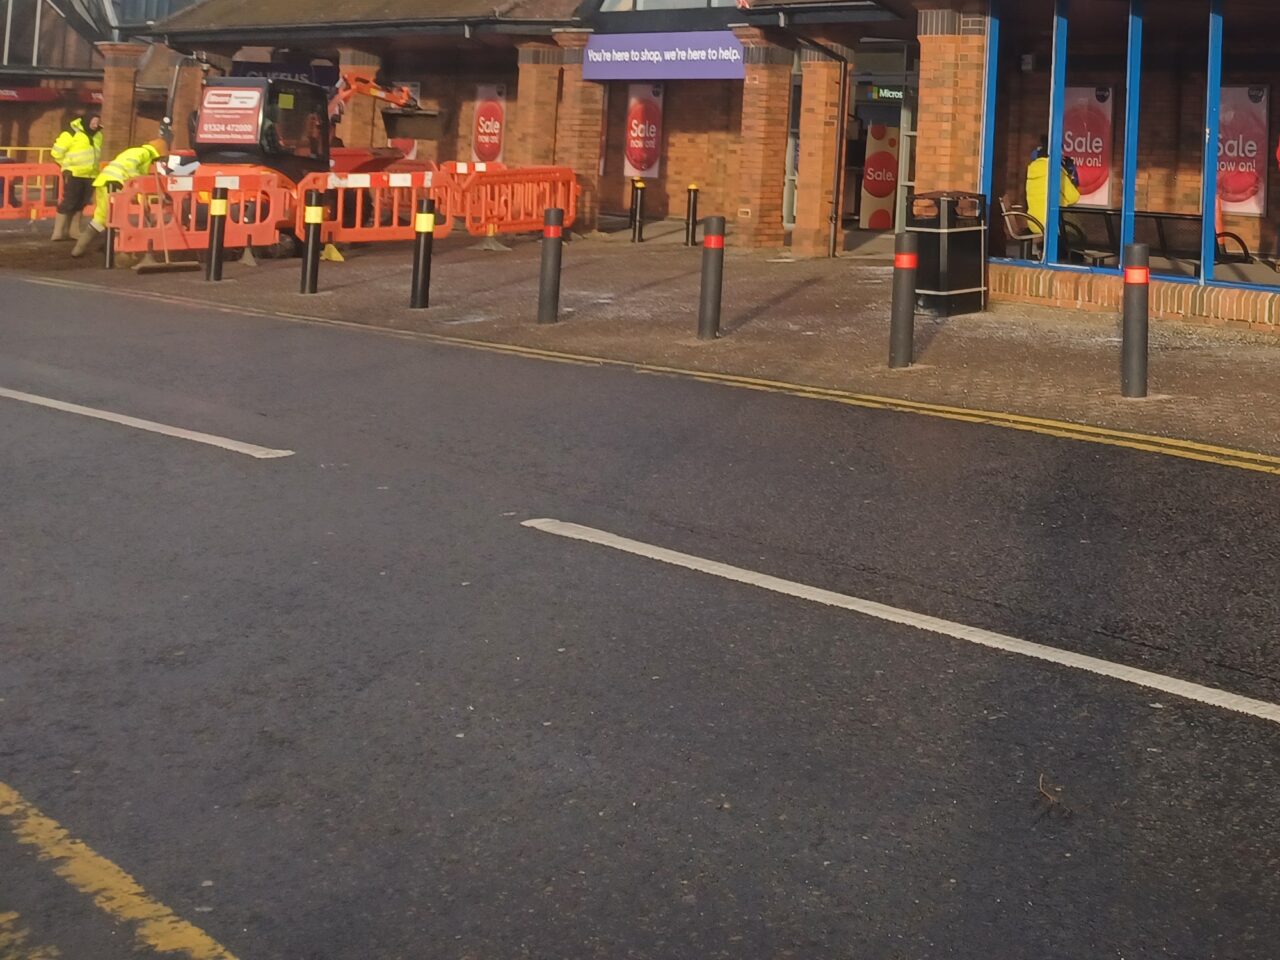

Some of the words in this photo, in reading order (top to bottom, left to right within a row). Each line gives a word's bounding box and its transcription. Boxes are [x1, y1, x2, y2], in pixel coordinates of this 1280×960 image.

[588, 48, 611, 61] You're
[612, 49, 630, 61] here
[631, 49, 640, 61] to
[641, 48, 662, 63] shop,
[664, 48, 685, 61] we're
[687, 47, 706, 60] here
[708, 47, 718, 60] to
[719, 46, 740, 62] help.
[478, 117, 500, 133] Sale
[630, 119, 656, 138] Sale
[630, 139, 643, 148] now
[1063, 131, 1103, 153] Sale
[1086, 155, 1102, 167] on!
[1239, 159, 1256, 172] on!
[866, 168, 895, 181] Sale.
